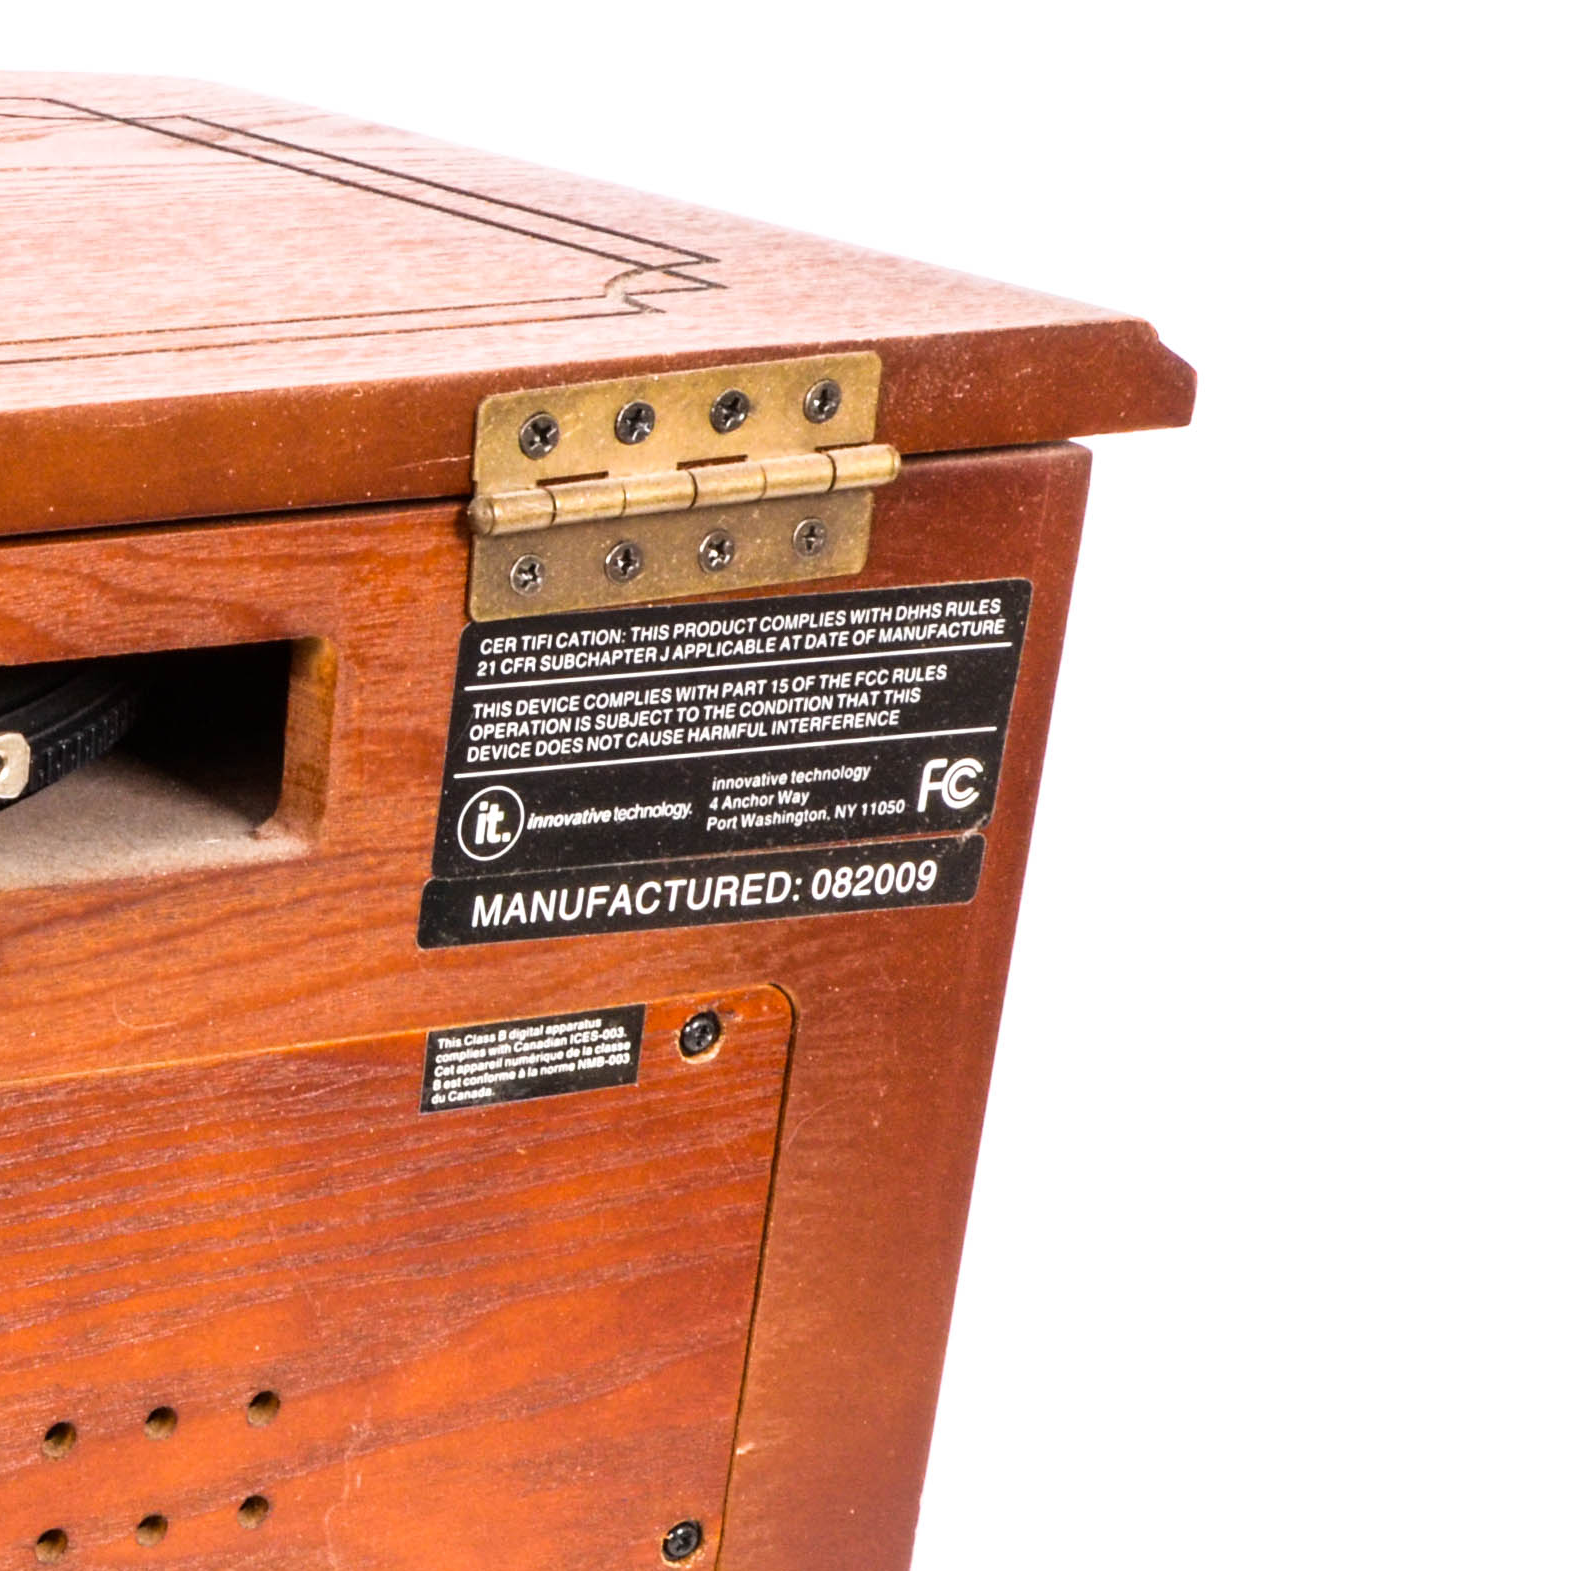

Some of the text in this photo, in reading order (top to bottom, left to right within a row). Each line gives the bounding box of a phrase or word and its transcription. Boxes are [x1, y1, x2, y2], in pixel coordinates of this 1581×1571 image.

[630, 597, 1002, 643] THIS PRODUCT COMPLIES WITH DHHS RULES
[476, 618, 1007, 677] 21 CFR SUBCHAPTER APPLICABLE AT DATE OF MANUFACTURE
[469, 686, 922, 742] OPERATION IS SUBJECT TO THE CONDITION THAT THIS
[472, 663, 948, 720] THIS DEVICE COMPLIES WITH PART 15 OF THE FCC RULES
[466, 709, 901, 763] DEVICE DOES NOT CAUSE HARMFUL INTERFERENCE
[708, 789, 810, 811] 4 Anchor Way
[711, 764, 872, 792] innovative technology
[526, 807, 613, 831] innovative
[706, 815, 738, 832] Port
[834, 803, 858, 819] NY
[861, 798, 906, 817] 11050
[471, 859, 938, 928] MANUFACTURED: 082009
